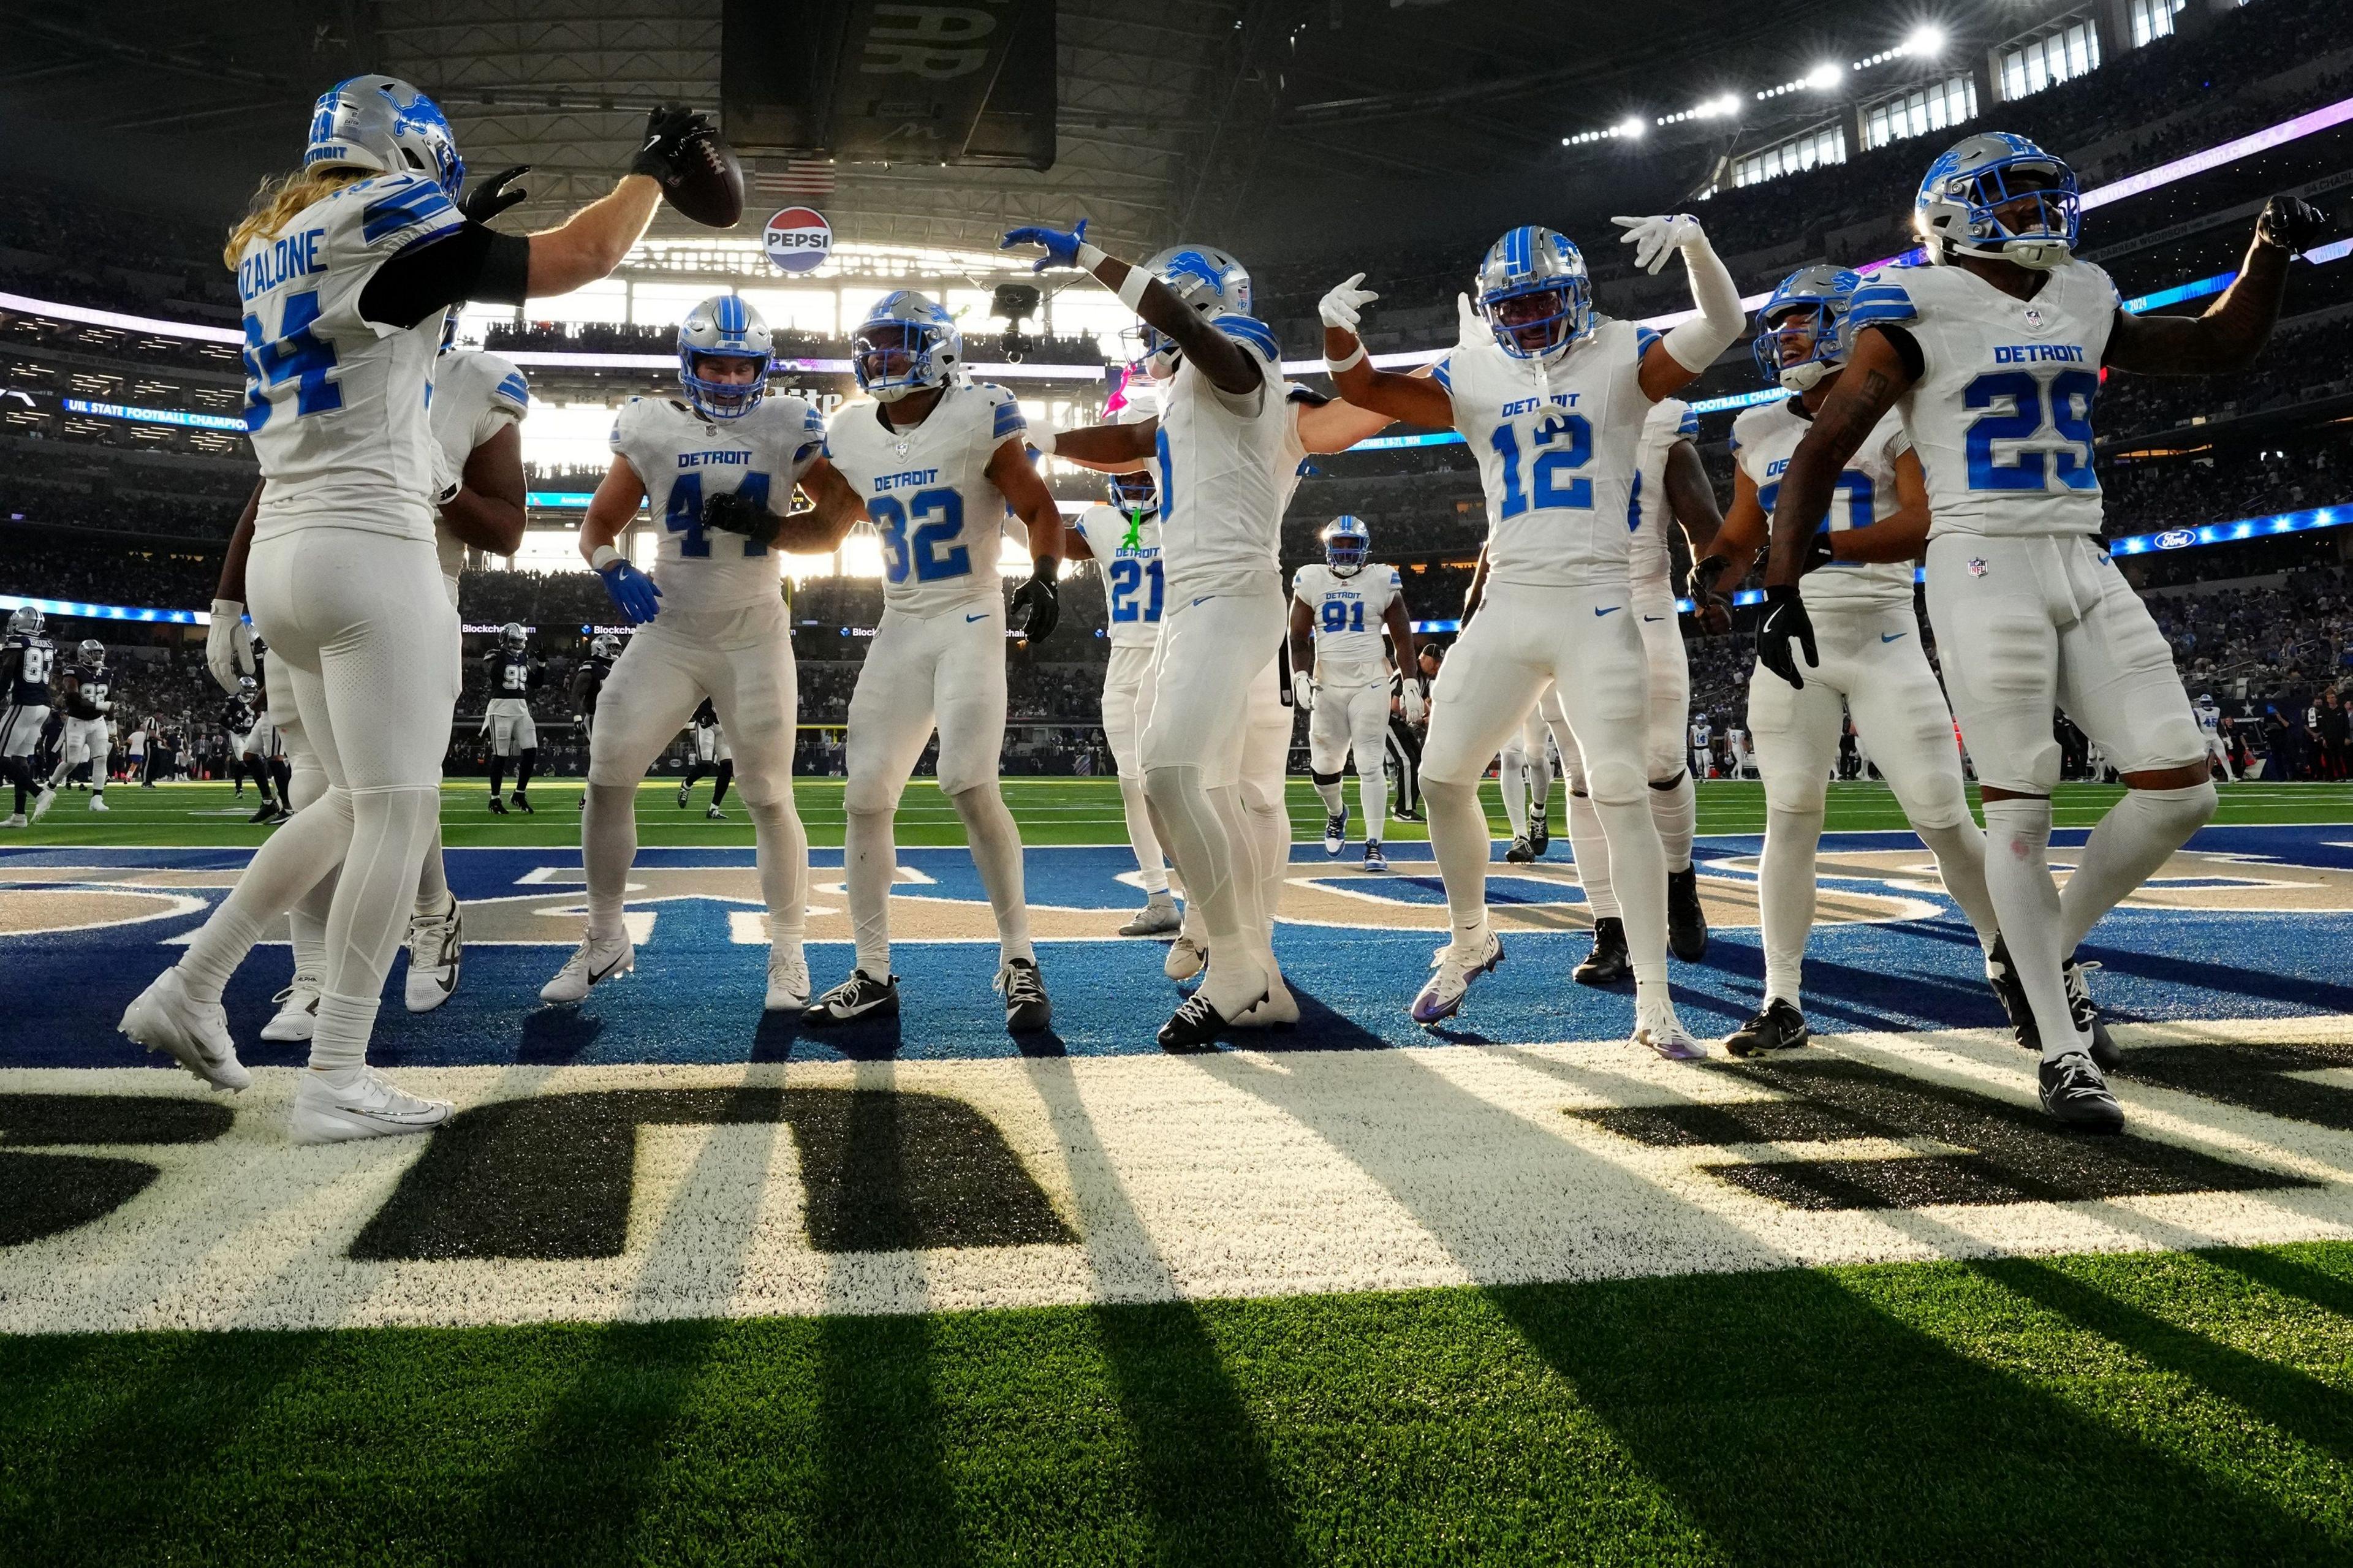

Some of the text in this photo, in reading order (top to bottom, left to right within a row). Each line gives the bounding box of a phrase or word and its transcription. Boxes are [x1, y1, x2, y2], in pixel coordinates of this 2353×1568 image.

[304, 146, 347, 165] TROIT
[767, 233, 828, 249] PEPSI
[240, 229, 329, 302] NZALONE
[2129, 298, 2146, 312] 2024
[1994, 345, 2084, 364] DETROIT
[69, 400, 89, 412] UIL
[91, 402, 124, 417] STATE
[126, 406, 184, 423] FOOTBALL
[1502, 393, 1580, 419] DETOIT
[1692, 387, 1792, 412] FOOTBALL CHAMPI
[1962, 369, 2099, 492] 29
[678, 451, 753, 468] DETROIT
[1491, 412, 1593, 522] 12
[874, 468, 937, 493] DETROIT
[665, 471, 772, 558] 44
[866, 487, 969, 585] 32
[2162, 531, 2186, 548] Ford
[1115, 546, 1160, 560] DETROIT
[1108, 559, 1164, 624] 21
[1325, 591, 1362, 601] DETROIT
[1322, 600, 1366, 633] 91
[594, 625, 636, 634] Blockcha
[23, 646, 53, 685] 83
